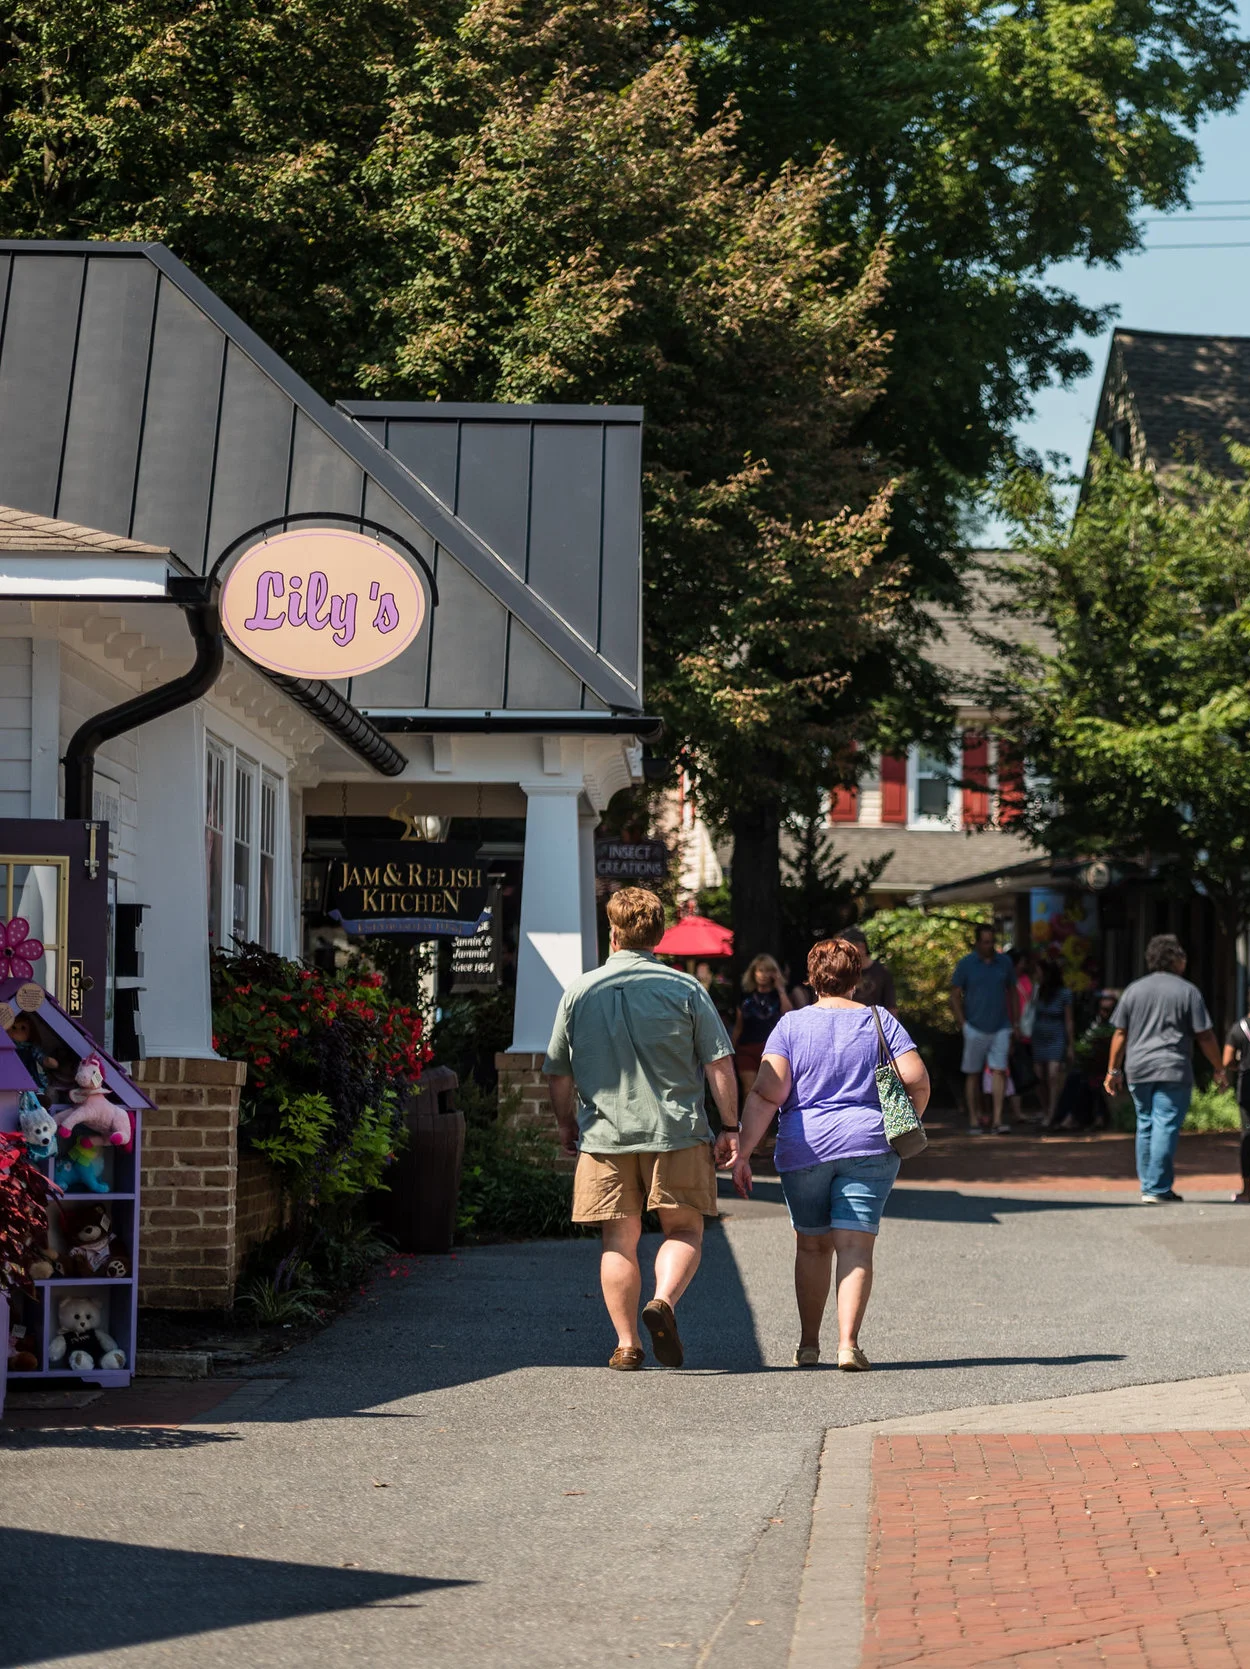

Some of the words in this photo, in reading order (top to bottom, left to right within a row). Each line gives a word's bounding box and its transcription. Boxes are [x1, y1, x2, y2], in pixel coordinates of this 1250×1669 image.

[244, 570, 400, 647] Lily's
[608, 845, 651, 859] INSECT
[407, 862, 482, 888] RELISH
[597, 860, 662, 875] CREATIONS
[361, 887, 462, 913] KITCHEN
[71, 966, 80, 1011] PUSH
